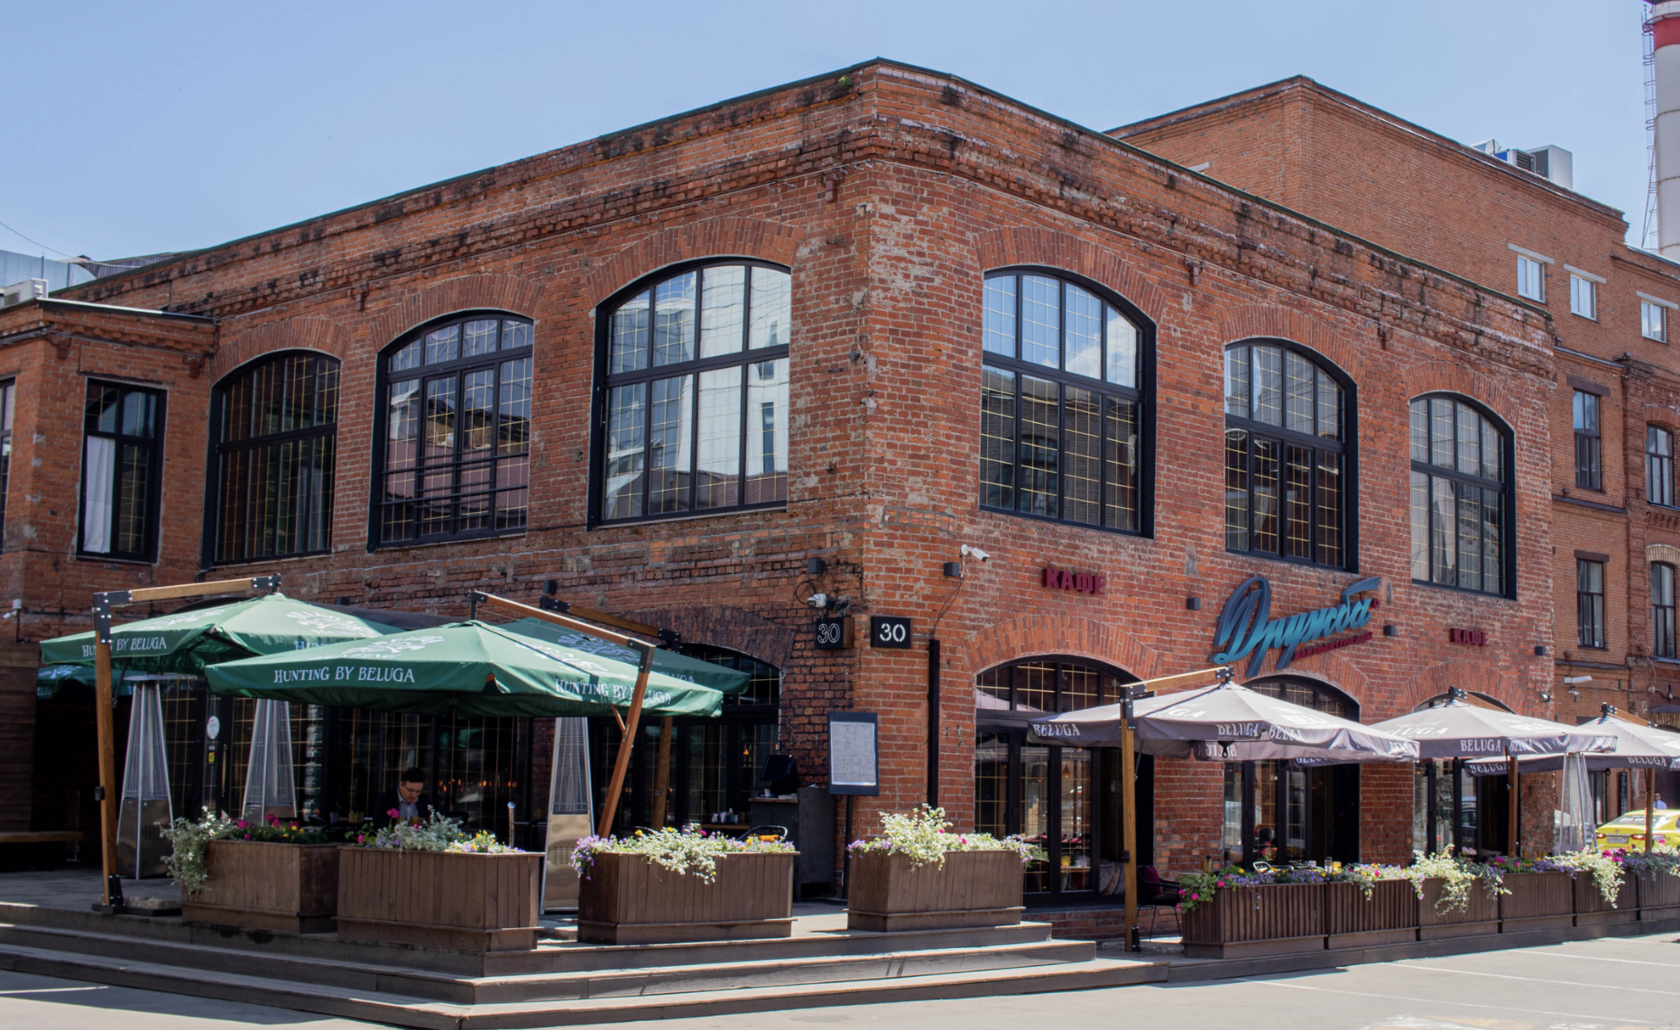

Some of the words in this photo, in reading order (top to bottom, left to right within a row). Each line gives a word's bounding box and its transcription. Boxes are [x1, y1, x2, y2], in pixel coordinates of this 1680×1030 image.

[1044, 568, 1106, 595] КАФЕ
[817, 623, 841, 643] 30
[880, 623, 906, 642] 30
[1209, 577, 1381, 677] Дружба
[116, 638, 130, 651] BY
[130, 637, 167, 650] BELUGA
[1451, 628, 1489, 646] КАФЕ
[273, 667, 330, 683] HUNTING
[335, 666, 354, 680] BY
[358, 667, 415, 683] BELUGA
[555, 679, 609, 697] HUNTING
[613, 684, 627, 699] BY
[1033, 723, 1081, 736] BELUGA
[1216, 723, 1259, 736] BELUGA
[1460, 739, 1501, 752] BELUGA
[1627, 756, 1667, 767] BELUGA
